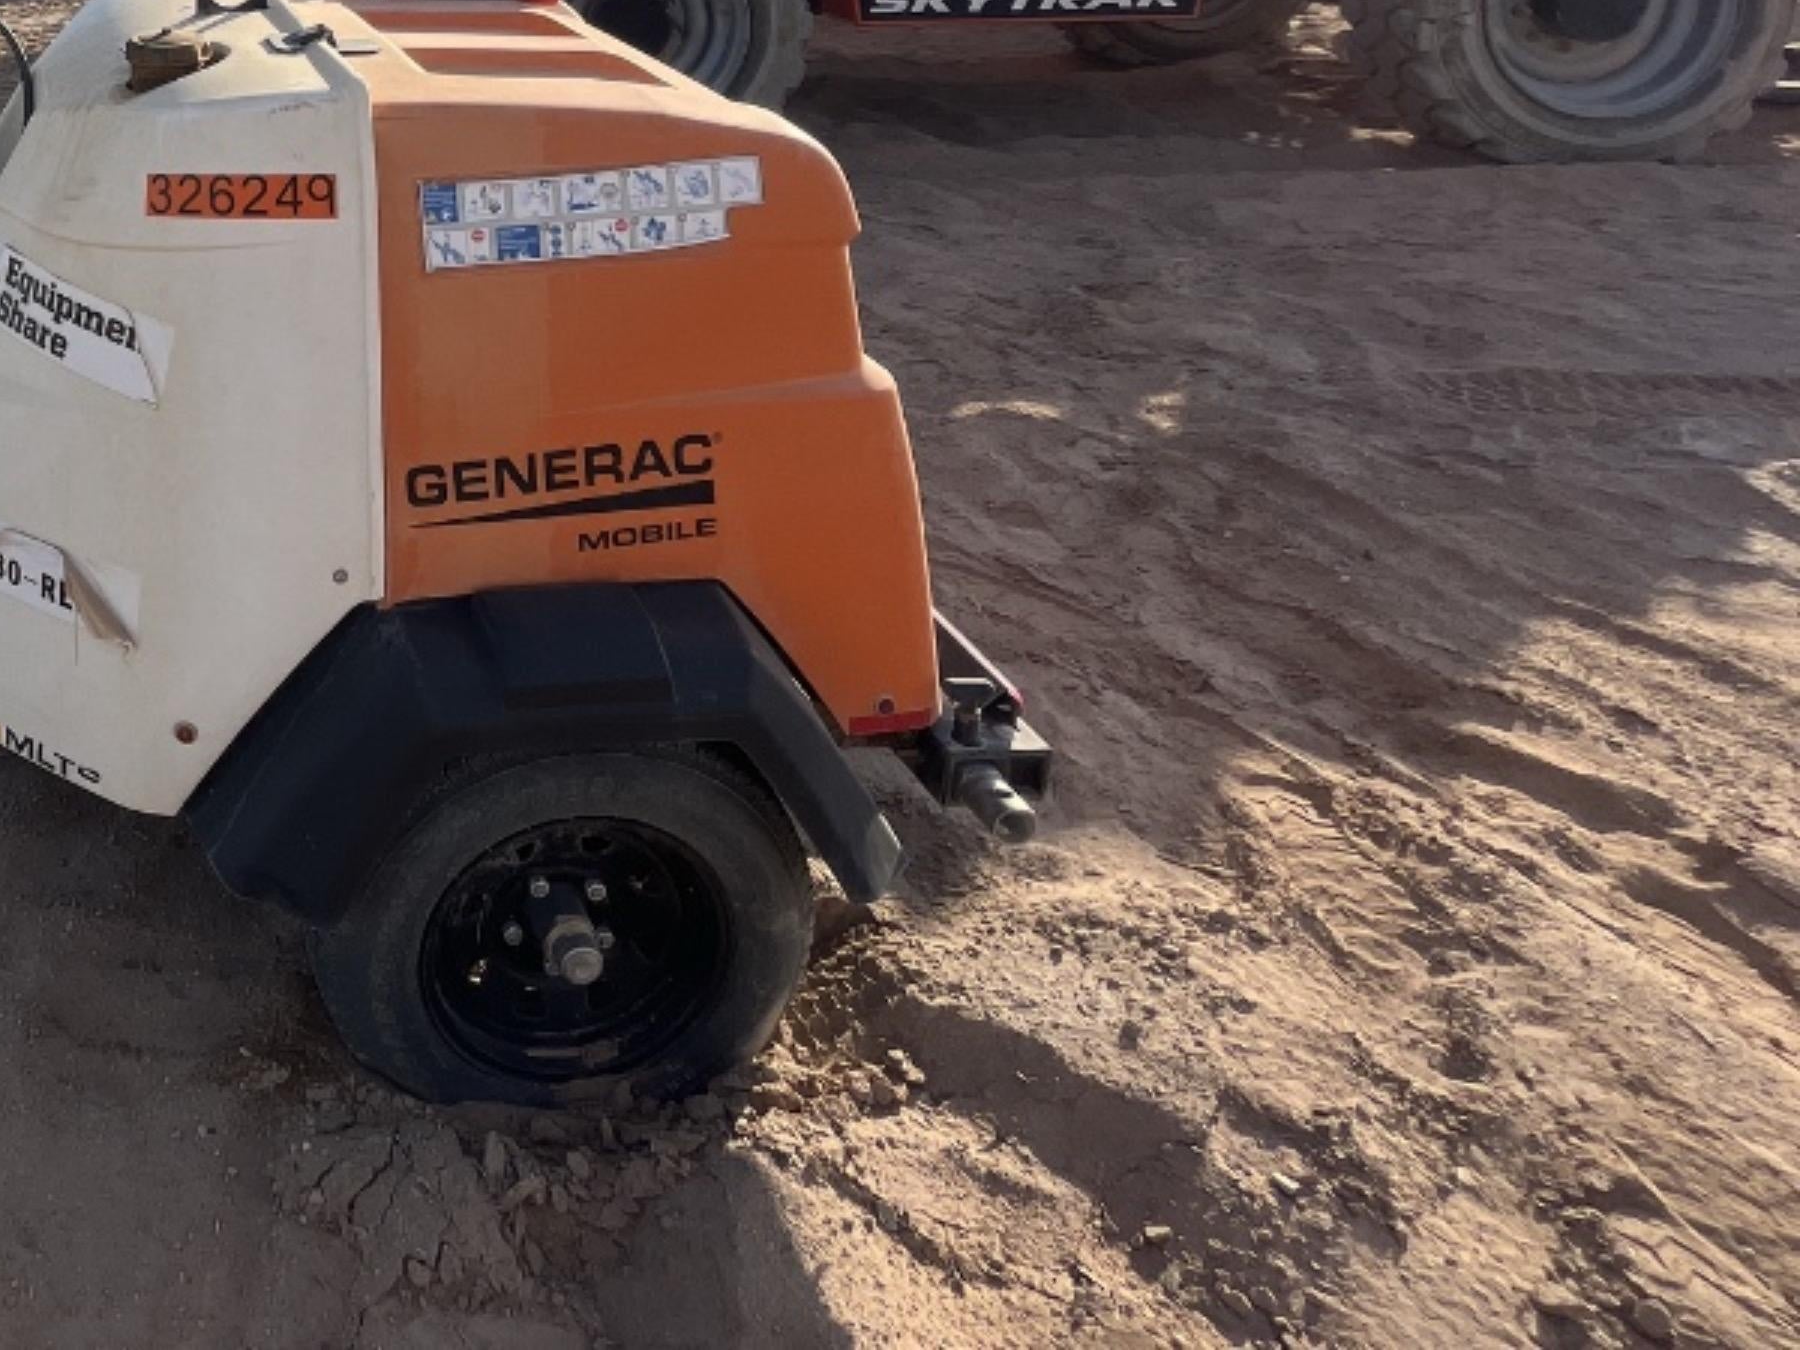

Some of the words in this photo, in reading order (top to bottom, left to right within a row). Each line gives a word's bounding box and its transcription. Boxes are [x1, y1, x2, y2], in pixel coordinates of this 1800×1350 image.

[150, 173, 337, 216] 326249
[406, 433, 712, 507] GENERAC
[577, 518, 717, 552] MOBILE
